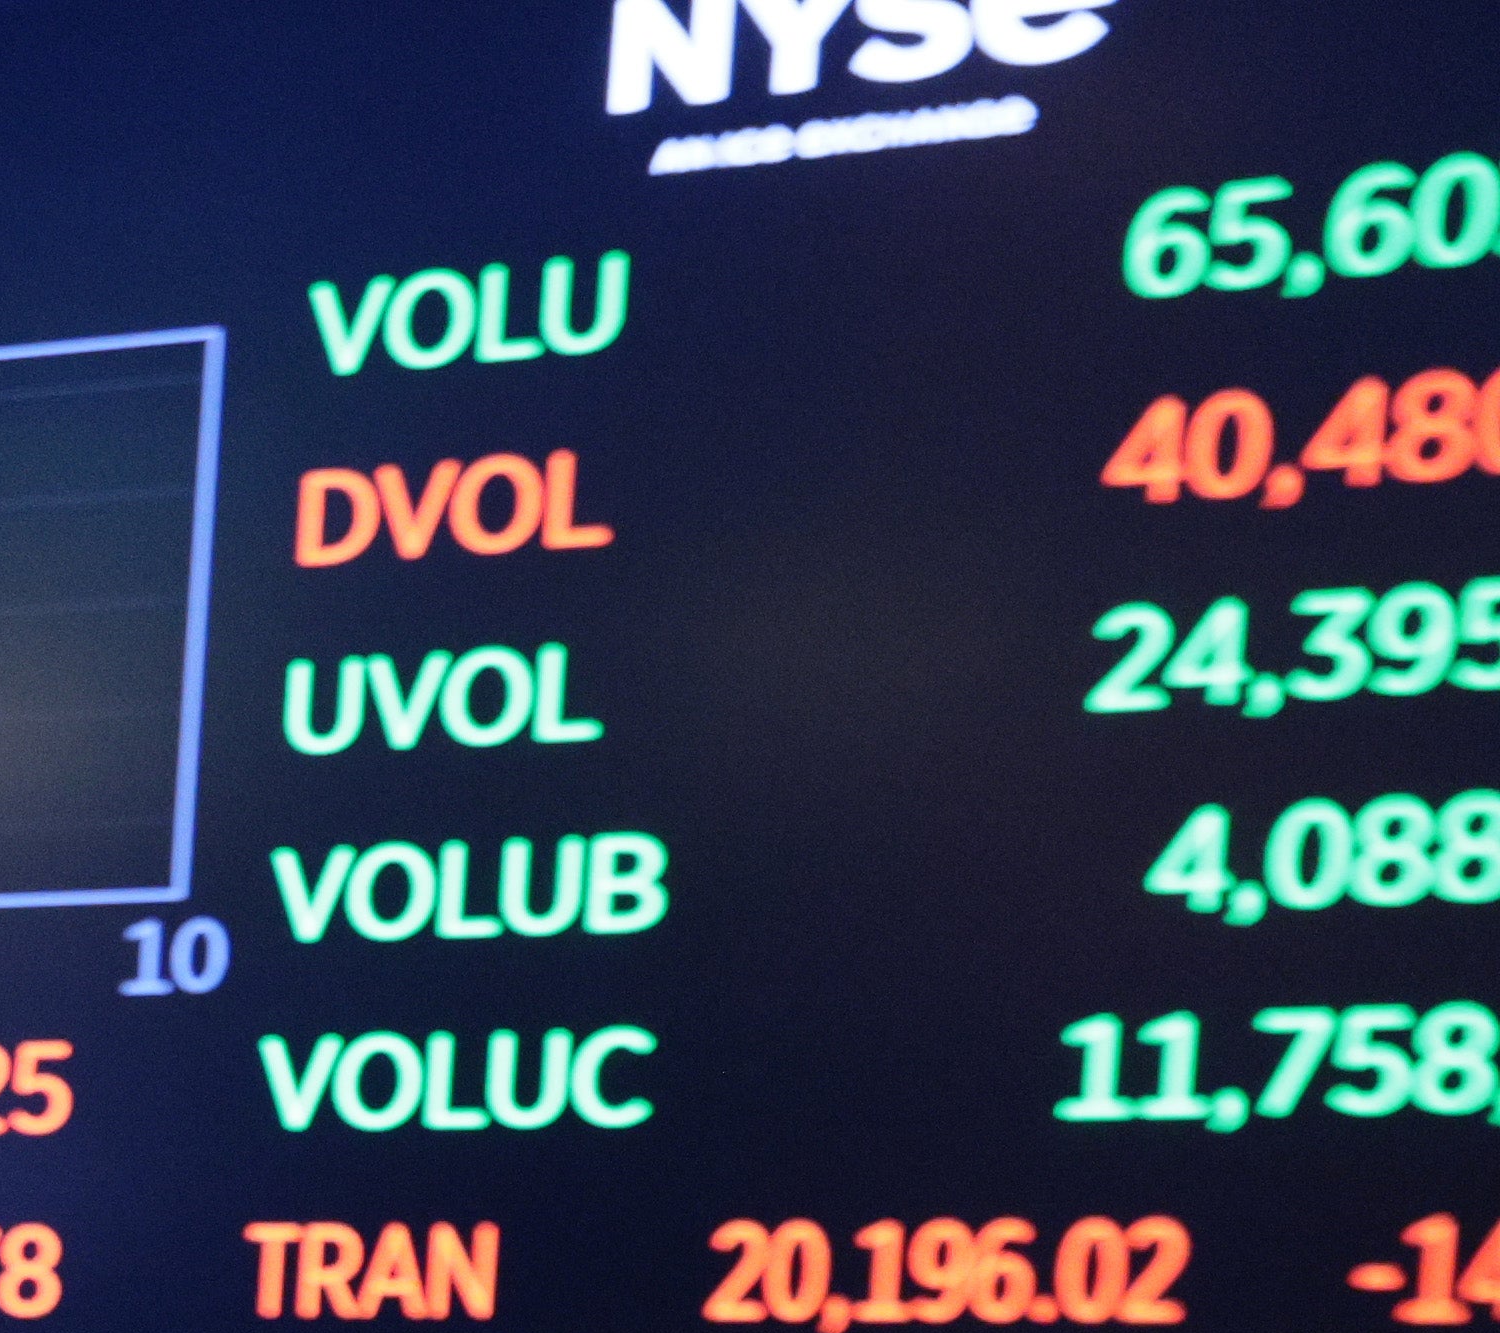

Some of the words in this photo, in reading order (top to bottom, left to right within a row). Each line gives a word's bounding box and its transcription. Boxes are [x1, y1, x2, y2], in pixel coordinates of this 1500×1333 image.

[309, 251, 629, 375] VOLU
[1124, 153, 1500, 298] 65,60
[295, 450, 613, 567] DVOL
[283, 643, 603, 755] UVOL
[271, 832, 668, 943] VOLUB
[1144, 789, 1500, 925] 4,088
[119, 916, 231, 996] 10
[259, 1025, 656, 1131] VOLUC
[244, 1222, 499, 1319] TRAN
